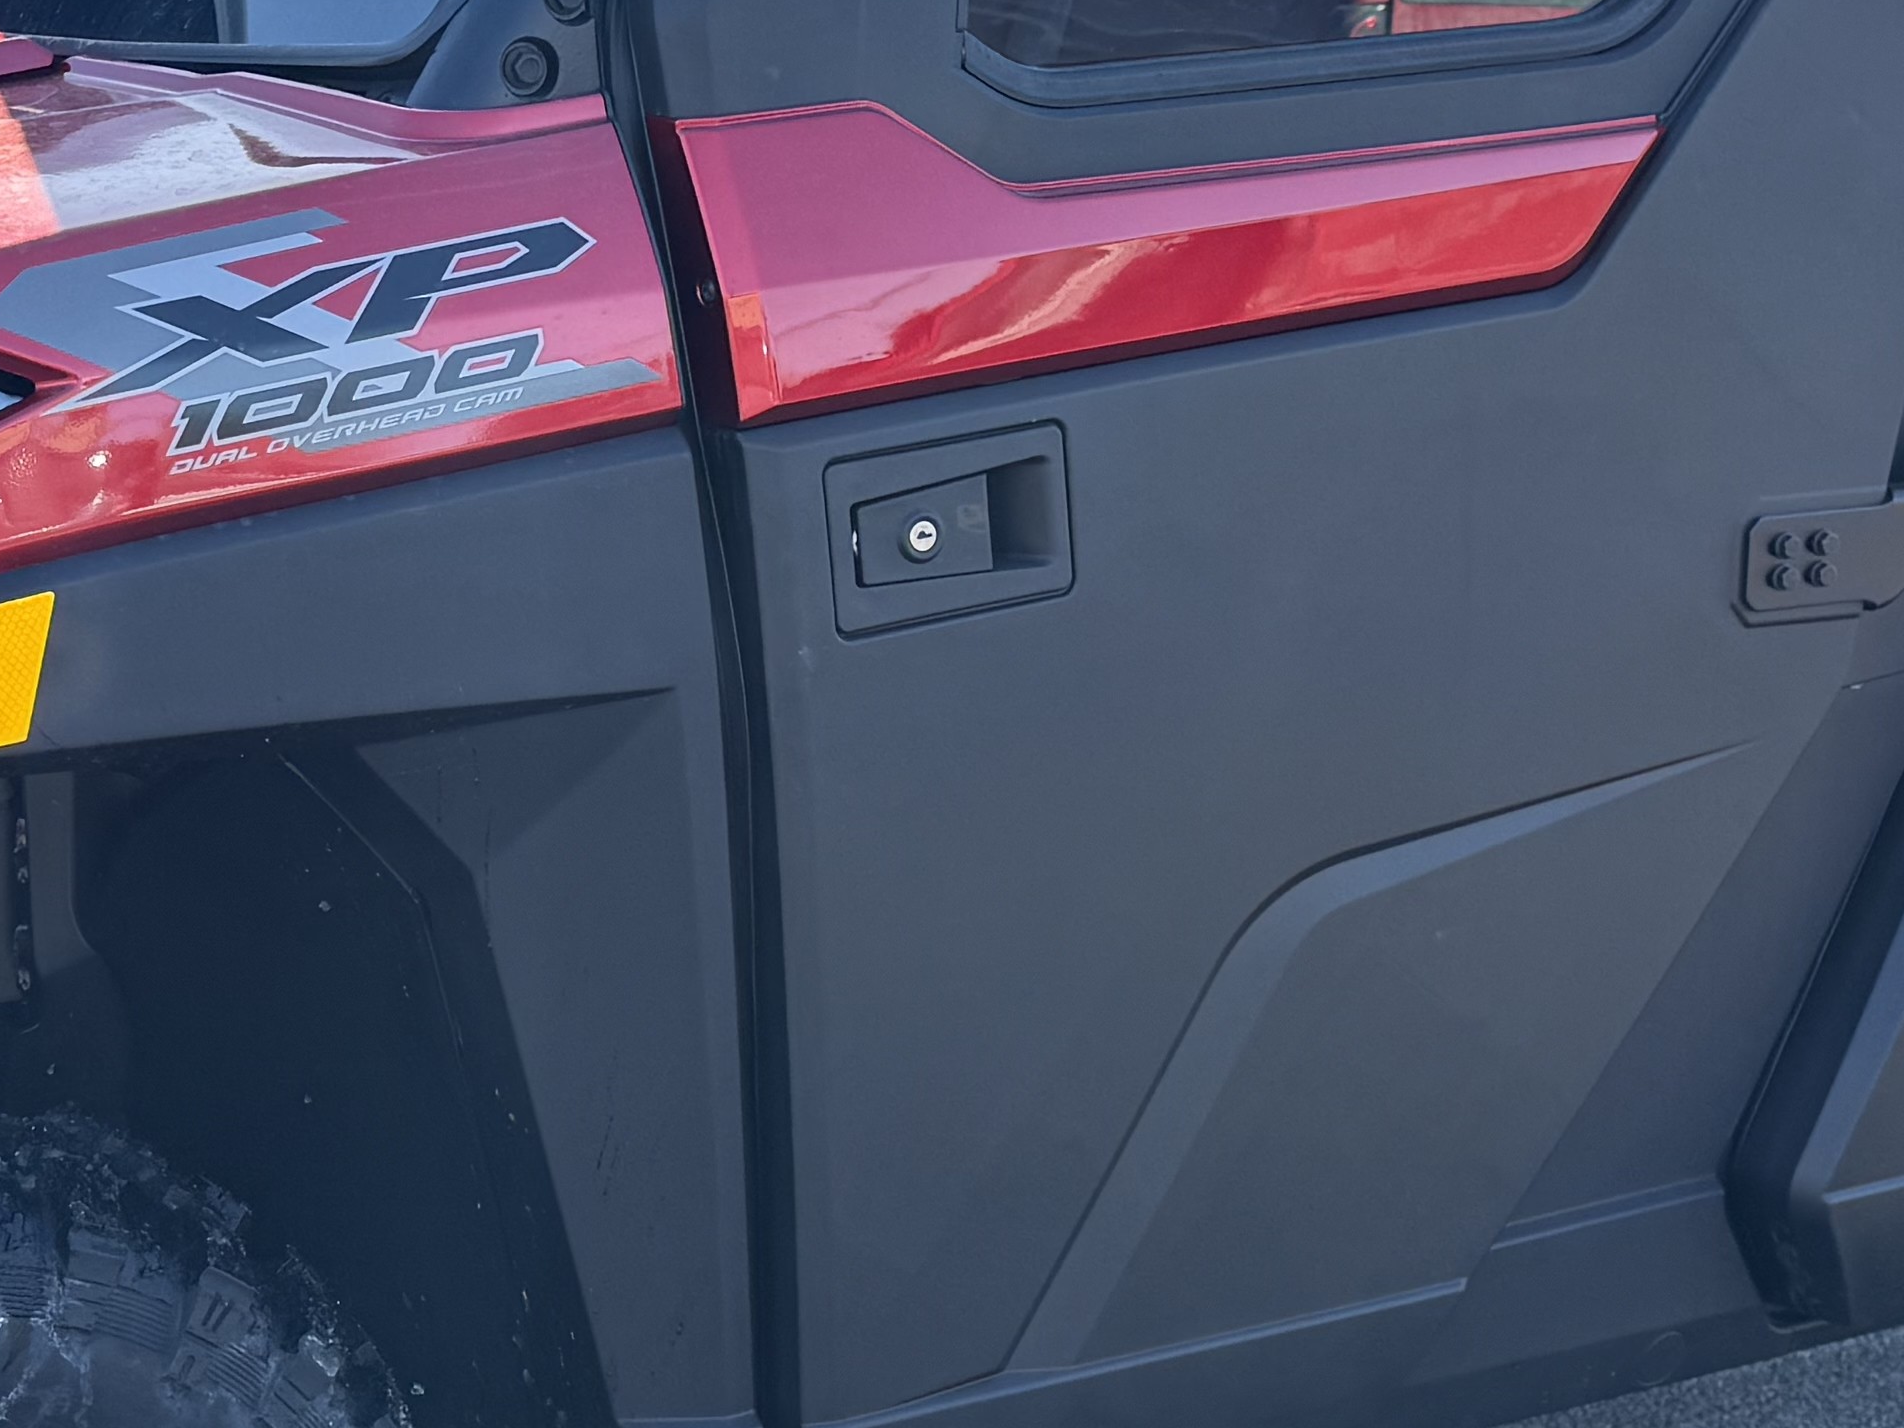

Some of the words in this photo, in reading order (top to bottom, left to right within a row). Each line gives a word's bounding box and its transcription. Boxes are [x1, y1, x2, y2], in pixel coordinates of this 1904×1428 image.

[41, 217, 597, 416] XP
[165, 329, 544, 456] 1000
[168, 444, 259, 476] DUAL
[266, 404, 446, 456] OVERHEAD
[452, 386, 525, 414] CAM
